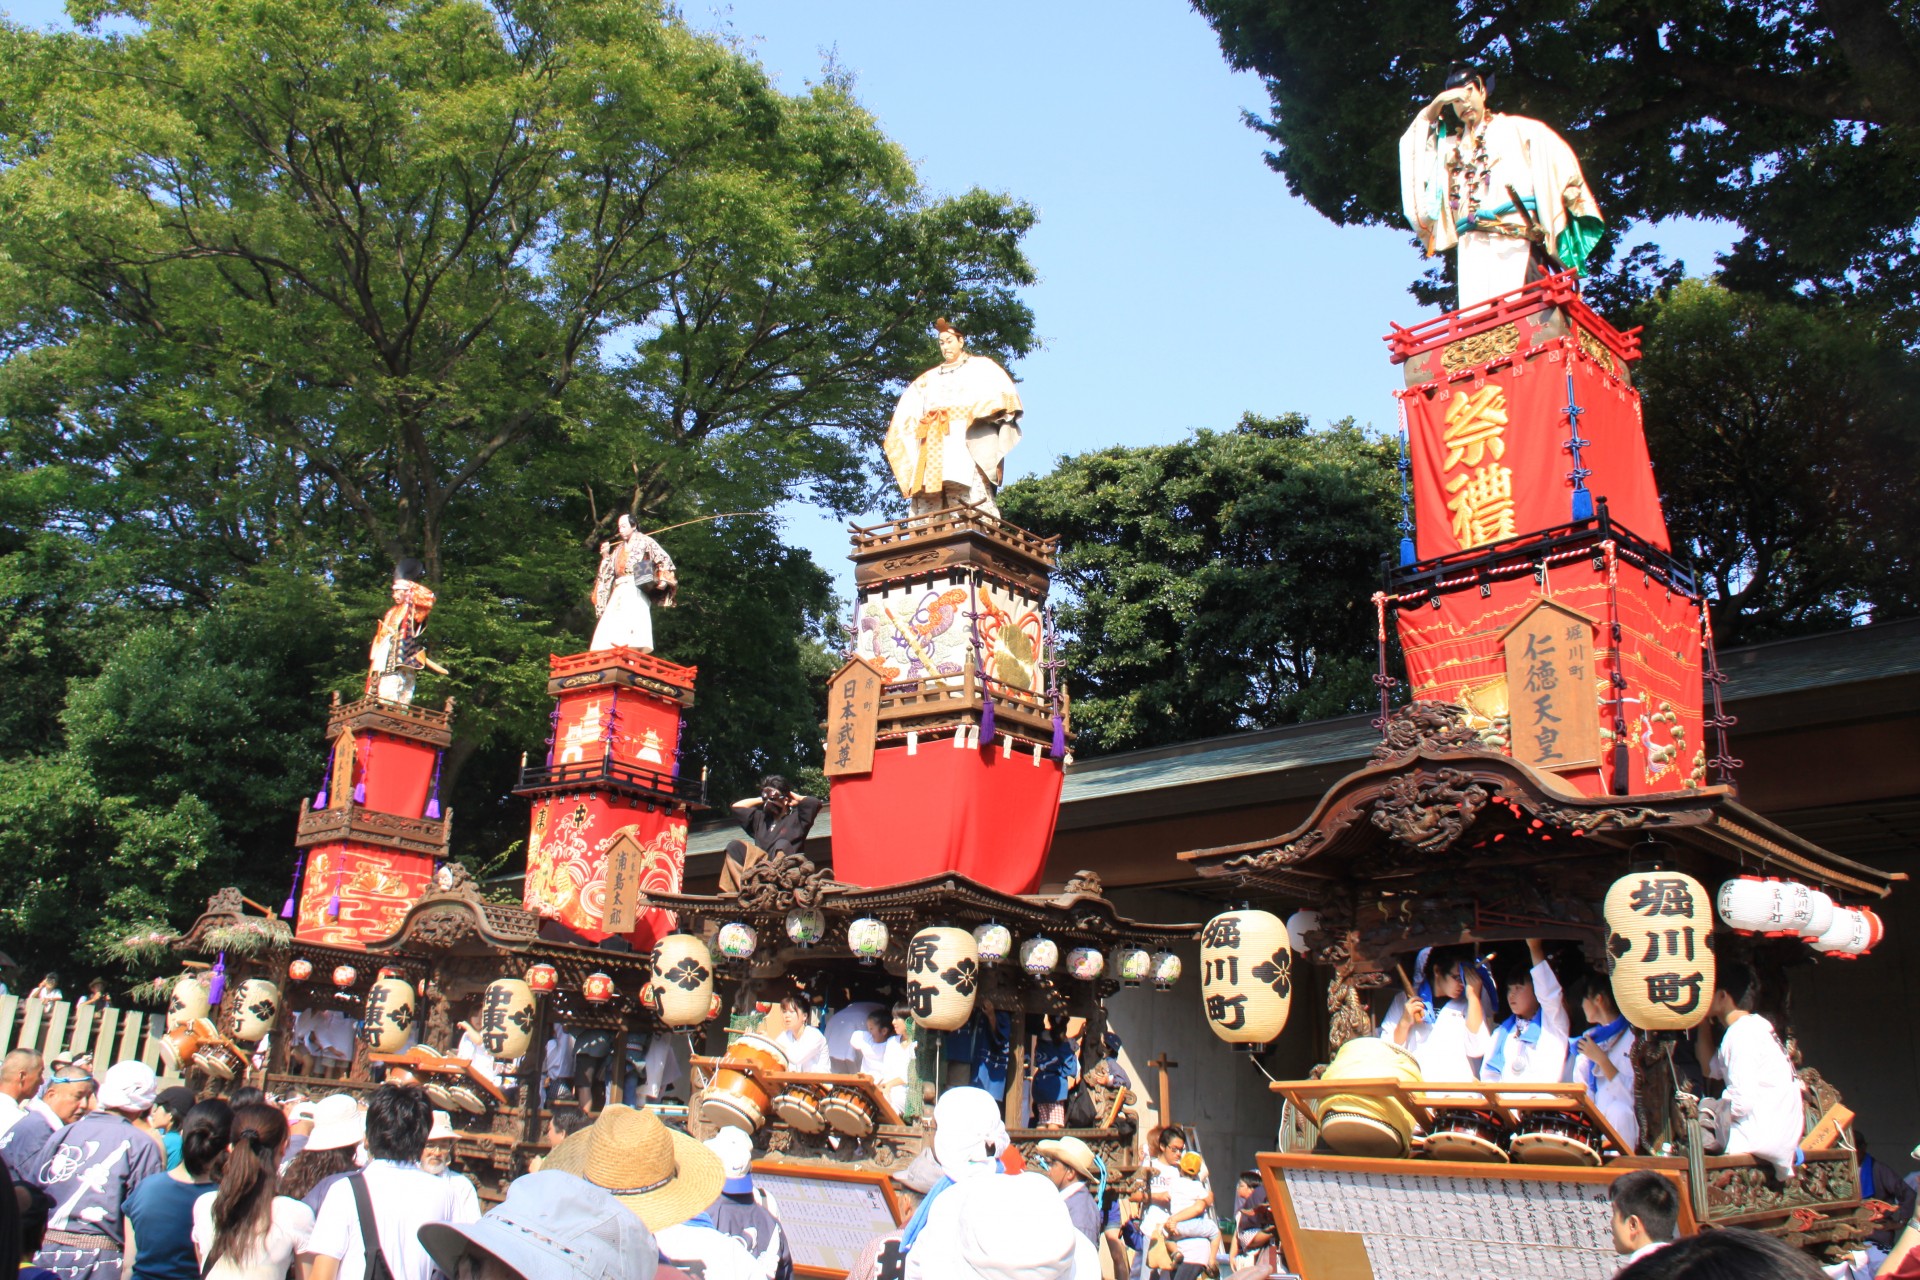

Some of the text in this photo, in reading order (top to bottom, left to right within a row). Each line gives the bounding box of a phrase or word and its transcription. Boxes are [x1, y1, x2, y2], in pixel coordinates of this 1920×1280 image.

[1443, 384, 1518, 550] 祭禮
[1565, 624, 1584, 680] 堀川町
[834, 679, 856, 768] 日本武尊
[863, 677, 873, 712] 原町
[609, 850, 628, 926] 浦島太郎
[1795, 887, 1809, 922] 堀川町
[908, 934, 941, 1018] 原町
[1202, 916, 1248, 1030] 堀川町
[1629, 878, 1704, 1015] 堀川町
